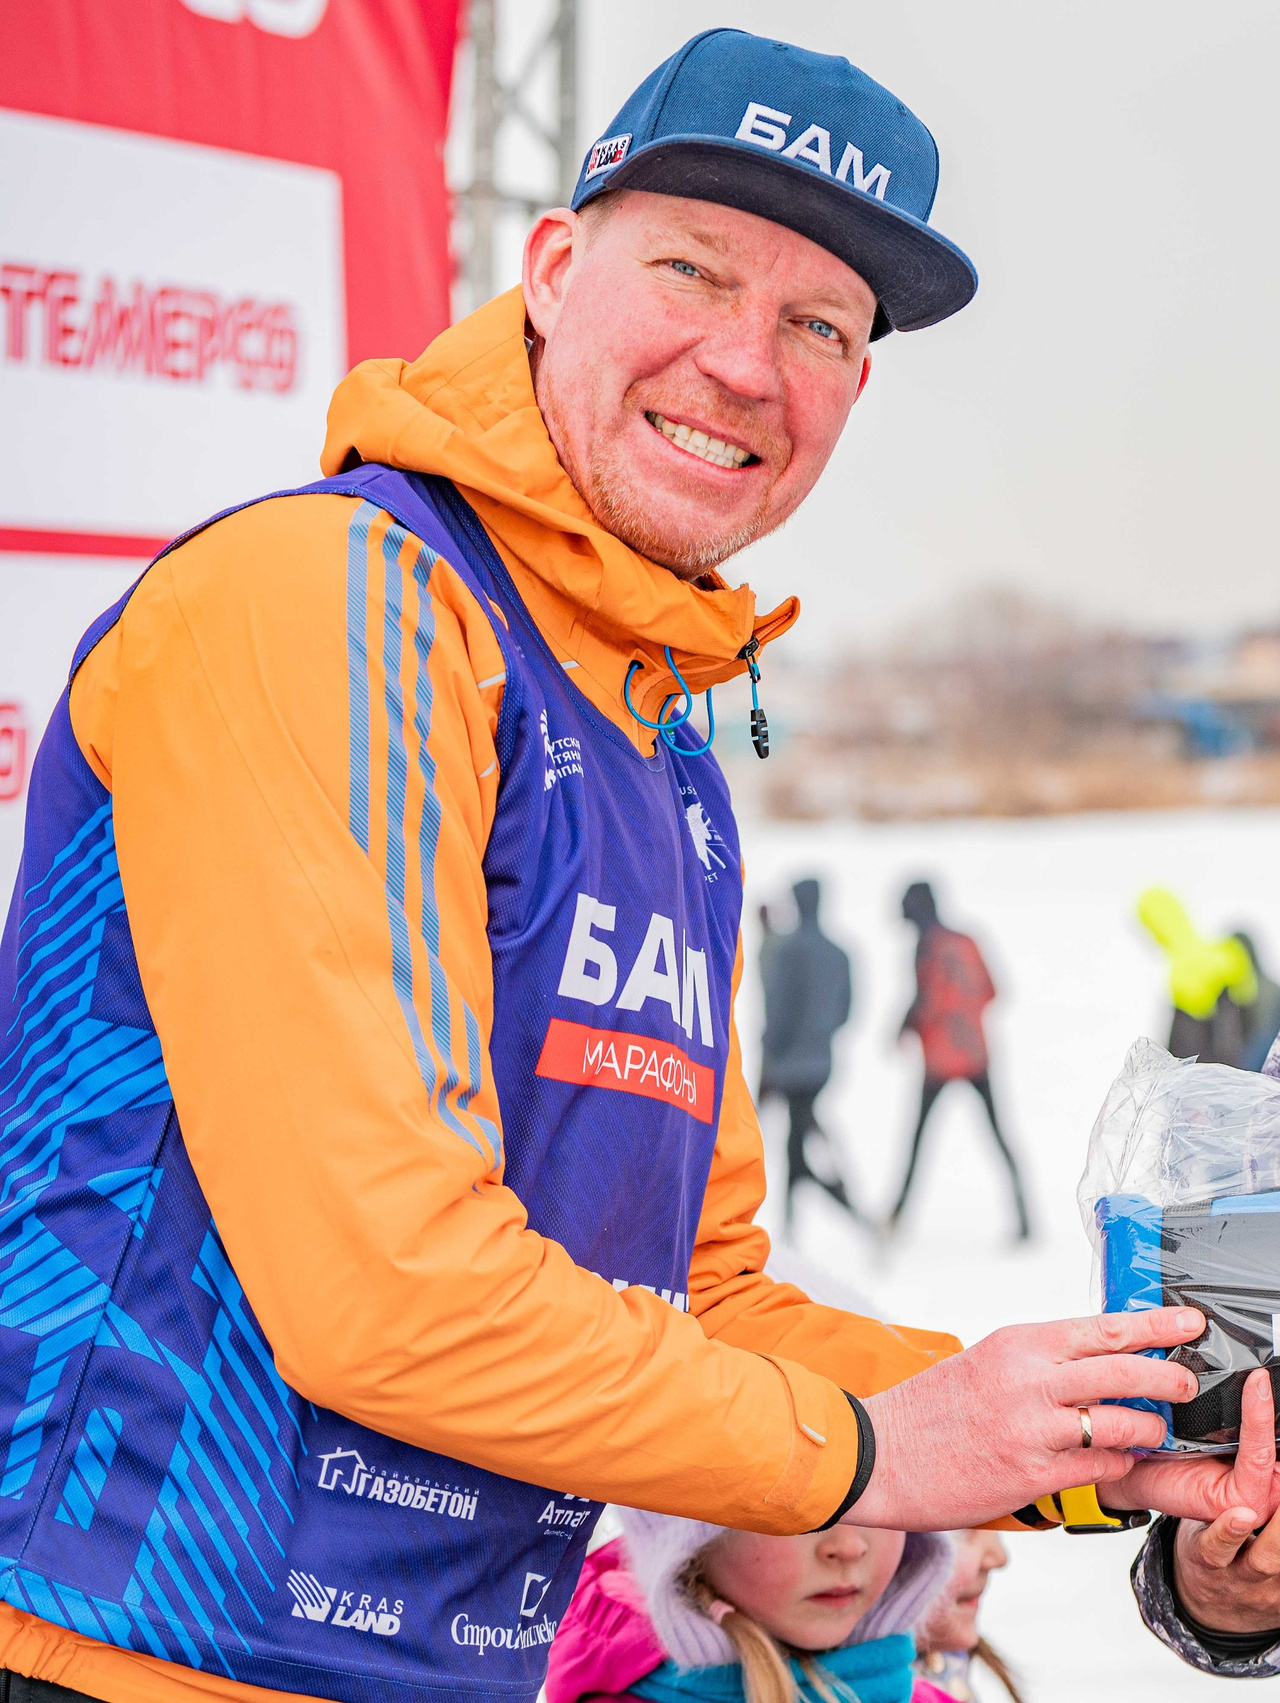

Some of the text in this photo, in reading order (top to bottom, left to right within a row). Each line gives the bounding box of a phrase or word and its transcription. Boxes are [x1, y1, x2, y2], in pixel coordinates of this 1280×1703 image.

[735, 101, 892, 201] БАМ
[557, 892, 714, 1049] БАМ
[582, 1037, 697, 1106] МАРАФОНЫ
[356, 1472, 478, 1521] ГАЗОБЕТОН
[369, 1465, 480, 1496] байкальский
[331, 1605, 401, 1637] LAND
[340, 1590, 405, 1615] KRAS
